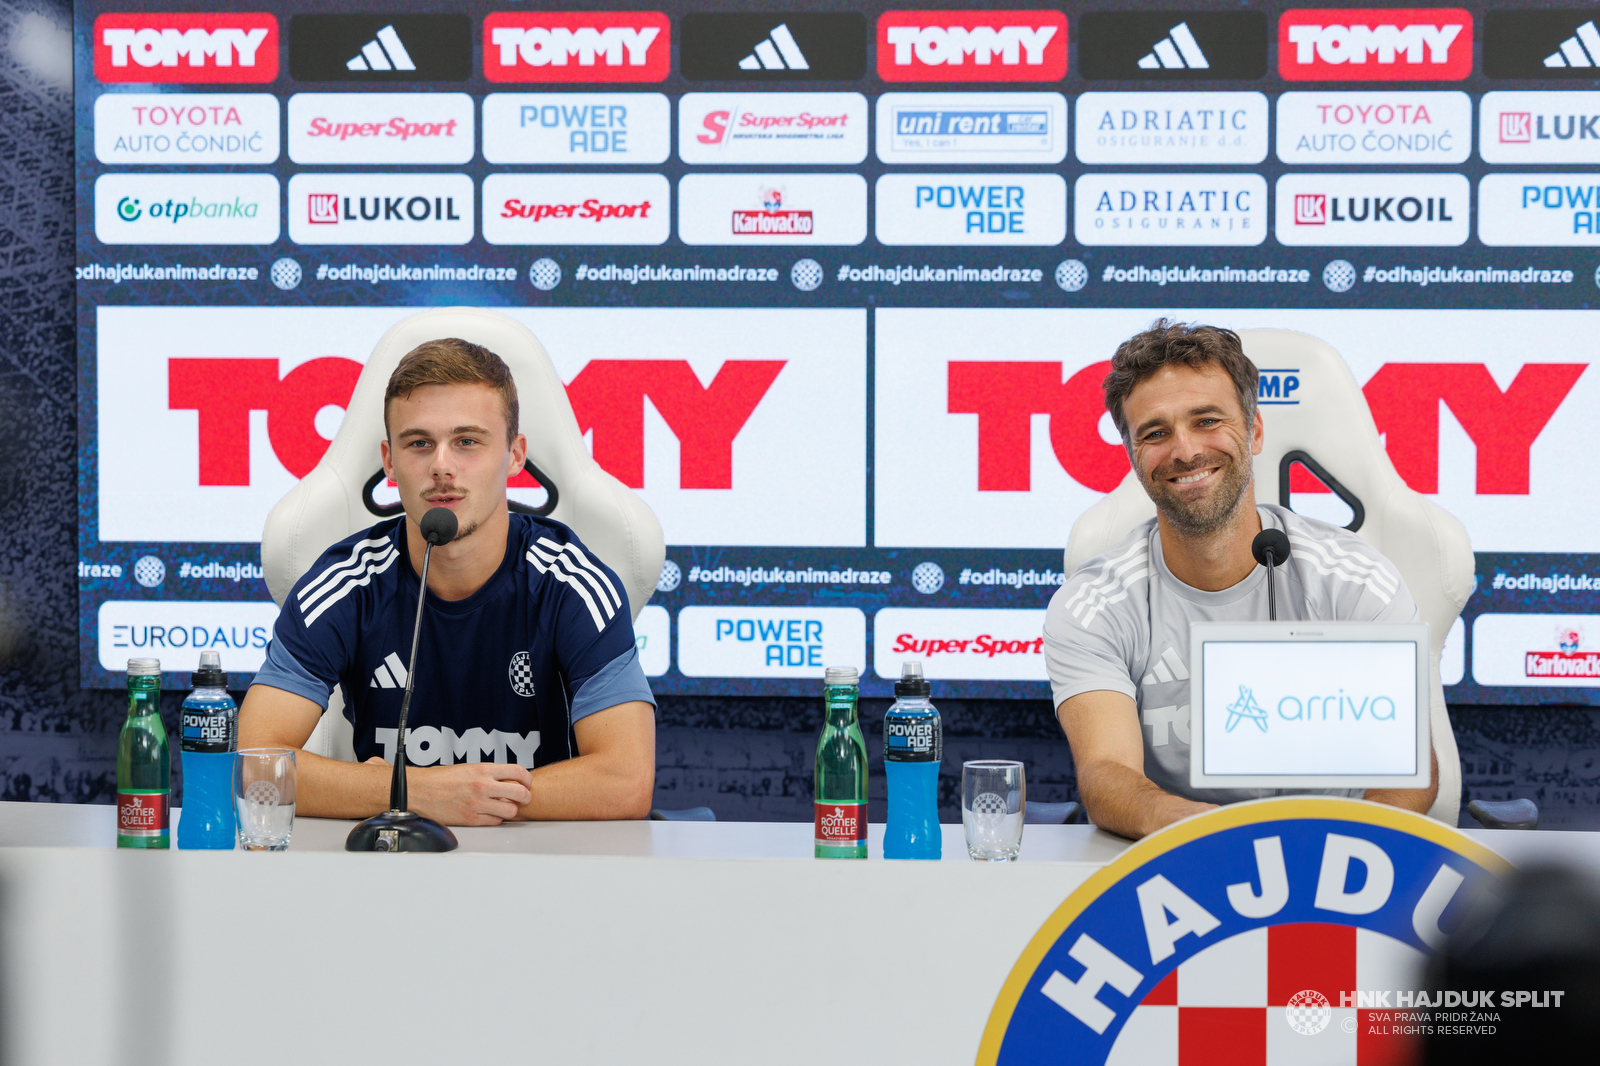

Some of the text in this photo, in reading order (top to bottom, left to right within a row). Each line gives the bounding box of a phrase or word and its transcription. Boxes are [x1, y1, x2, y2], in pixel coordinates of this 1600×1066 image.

[103, 27, 268, 67] TOMMY
[492, 27, 660, 66] TOMMY
[888, 26, 1058, 65] TOMMY
[1289, 24, 1462, 64] TOMMY
[133, 107, 242, 125] TOYOTA
[521, 105, 627, 128] POWER
[900, 113, 1002, 133] uni rent
[1100, 110, 1247, 131] ADRIATIC
[1317, 105, 1431, 124] TOYOTA
[114, 131, 262, 152] AUTO ČONDIĆ
[571, 131, 627, 152] ADE
[1097, 136, 1208, 147] OSIGURANJE
[1296, 130, 1452, 152] AUTO ČONDIĆ
[917, 186, 1023, 208] POWER
[1095, 191, 1250, 212] ADRIATIC
[1522, 186, 1600, 208] POW
[344, 196, 459, 221] LUKOIL
[1331, 198, 1452, 222] LUKOIL
[734, 212, 811, 232] Karlovačko
[967, 212, 1023, 233] ADE
[1095, 217, 1251, 231] OSIGURANJE
[317, 264, 517, 283] #odhajdukanimadraze
[576, 265, 778, 284] #odhajdukanimadraze
[838, 266, 1042, 285] #odhajdukanimadraze
[1102, 266, 1310, 285] #odhajdukanimadraze
[1364, 267, 1573, 286] #odhajdukanimadraze
[1258, 375, 1299, 397] MP
[689, 567, 891, 587] #odhajdukanimadraze
[717, 620, 823, 641] POWER
[766, 644, 823, 666] ADE
[1278, 689, 1395, 721] arriva
[184, 715, 226, 727] POWER
[889, 724, 932, 736] POWER
[201, 728, 226, 738] ADE
[908, 736, 932, 747] ADE
[375, 726, 541, 769] TOMMY
[975, 794, 1003, 805] HAJDUK
[121, 816, 154, 825] QUELLE
[821, 827, 855, 836] QUELLE
[1040, 832, 1498, 1035] HAJDU
